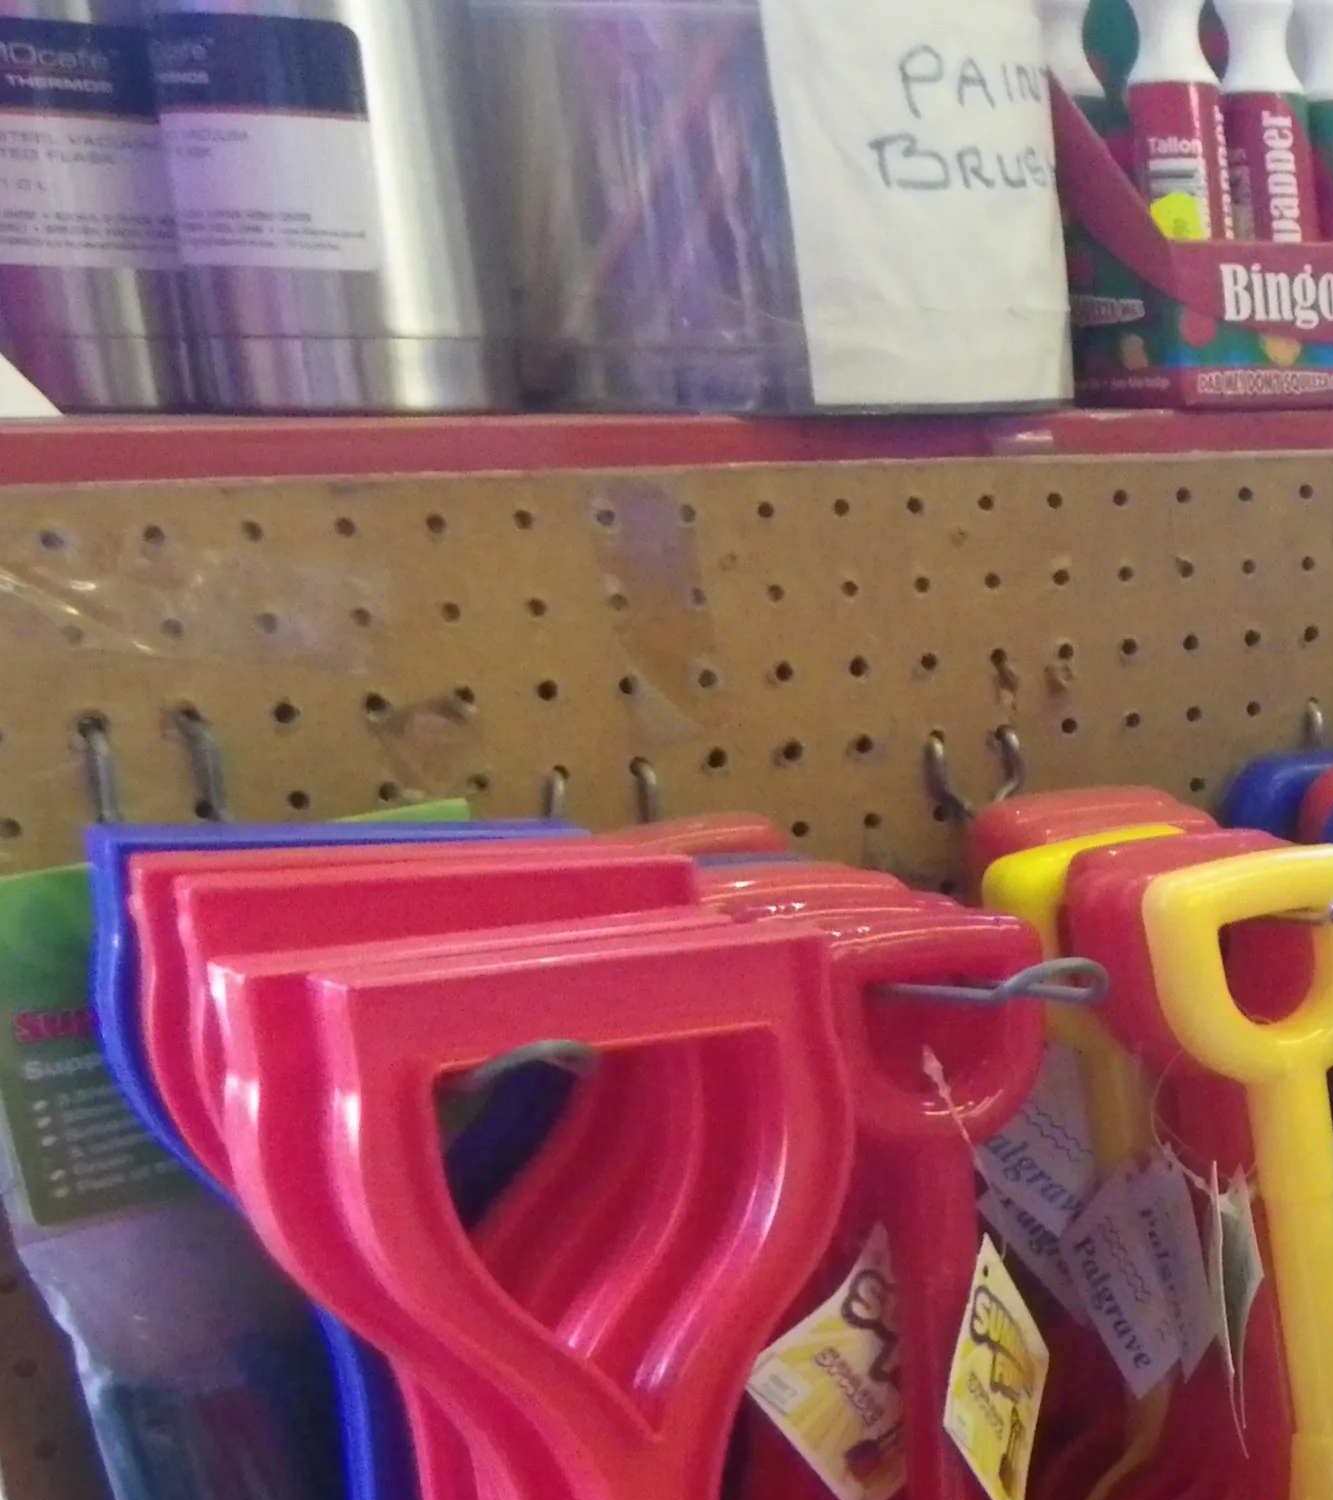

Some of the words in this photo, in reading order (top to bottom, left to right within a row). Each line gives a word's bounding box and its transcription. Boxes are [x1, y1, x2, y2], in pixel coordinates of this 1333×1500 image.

[6, 73, 113, 94] THERMOS
[1149, 136, 1203, 154] Tallon
[981, 1132, 1085, 1222] algrav
[1075, 1235, 1153, 1371] Palgrave
